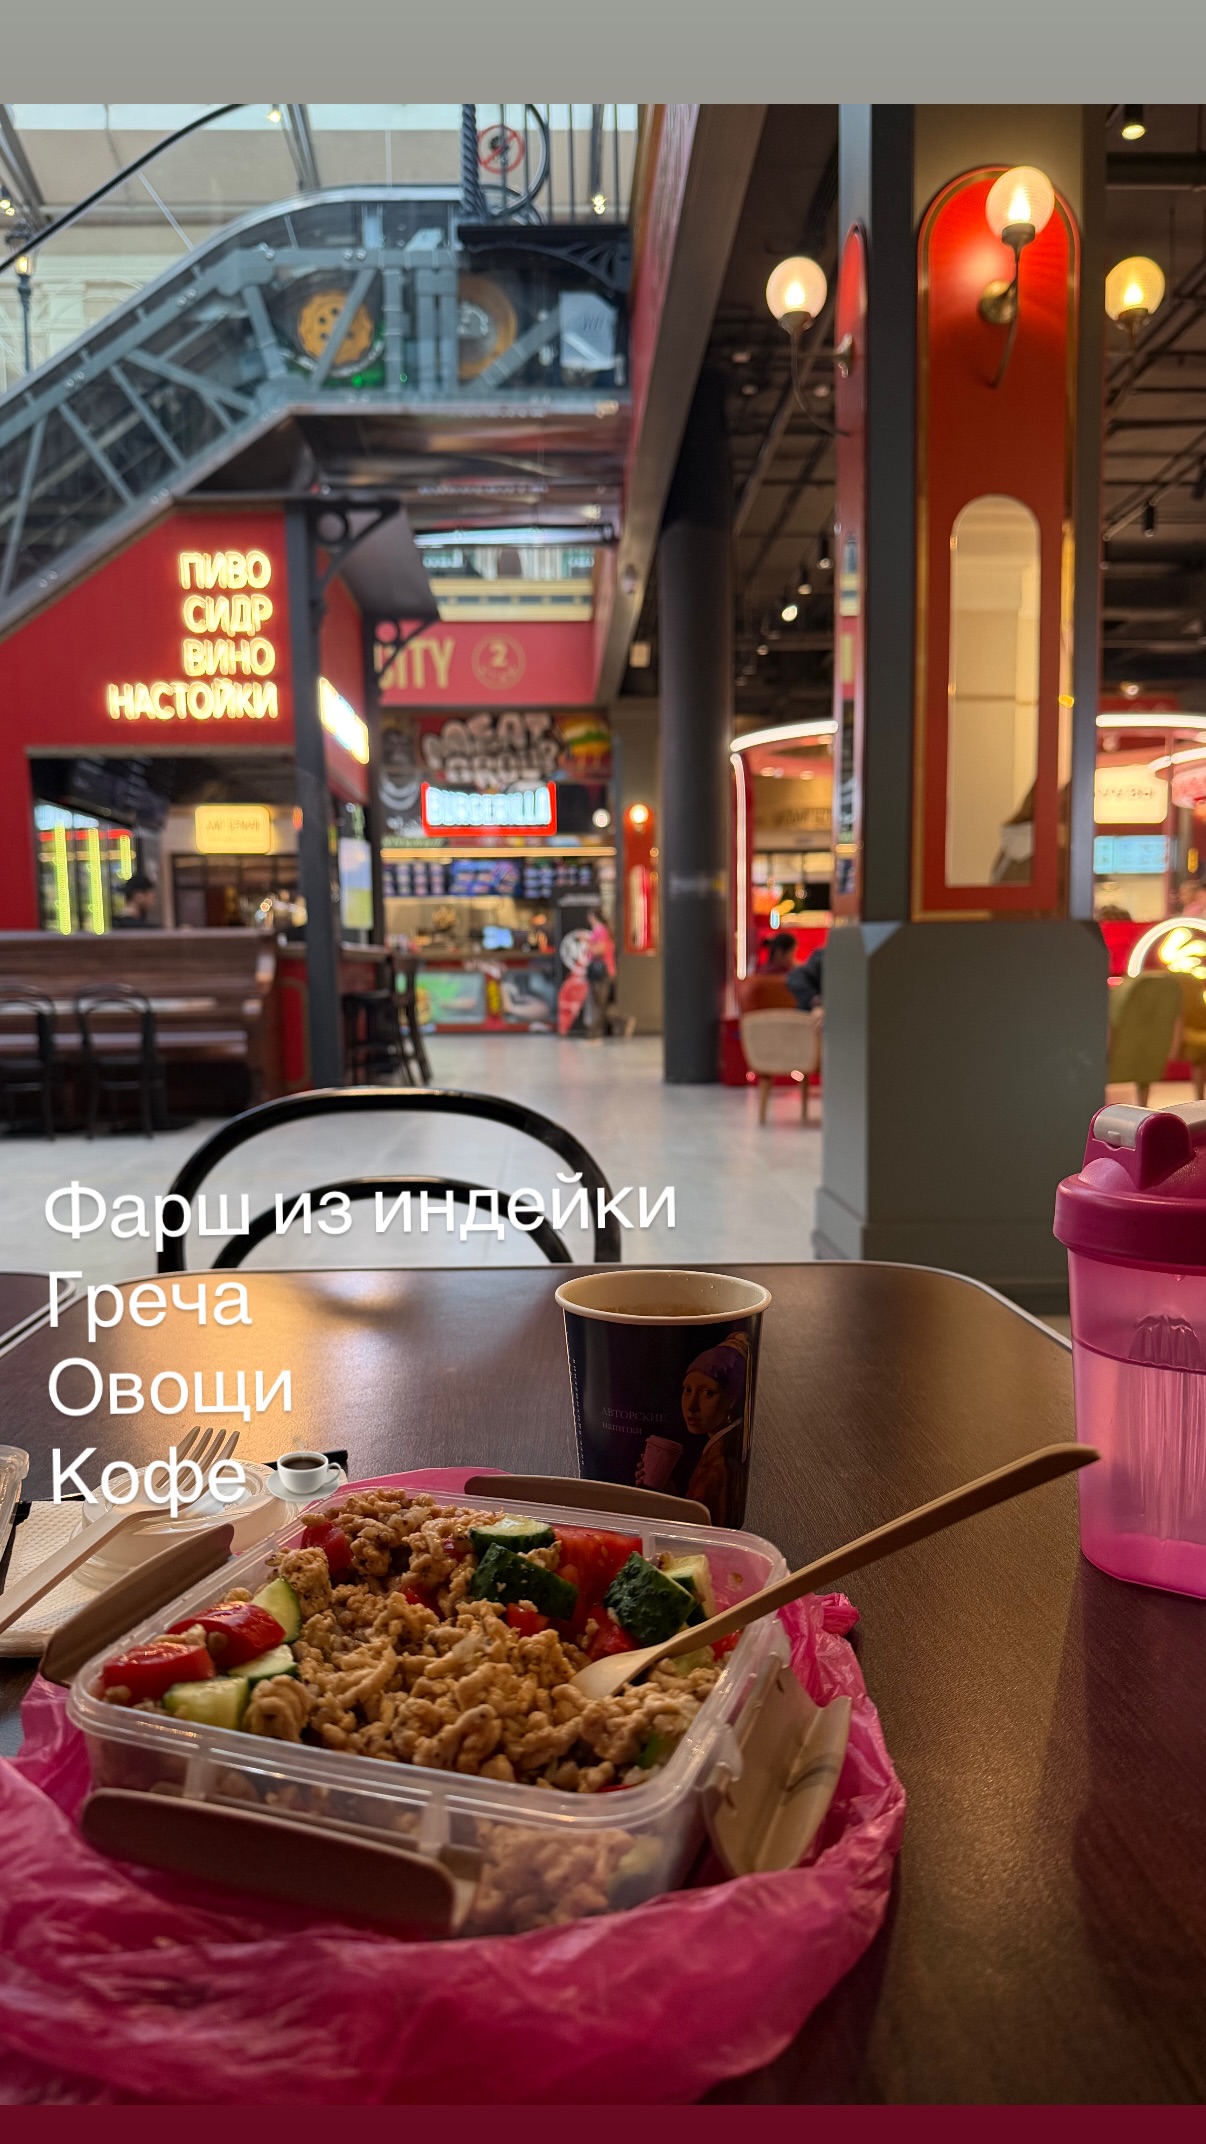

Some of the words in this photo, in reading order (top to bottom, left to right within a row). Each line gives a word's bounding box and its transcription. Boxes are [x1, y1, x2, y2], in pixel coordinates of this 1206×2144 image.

[179, 550, 272, 590] ПИВО
[182, 594, 274, 636] СИДР
[182, 637, 276, 676] ВИНО
[488, 639, 509, 668] 2
[107, 678, 279, 720] НАСТОЙКИ
[601, 1407, 669, 1423] АВТОРСКИЕ
